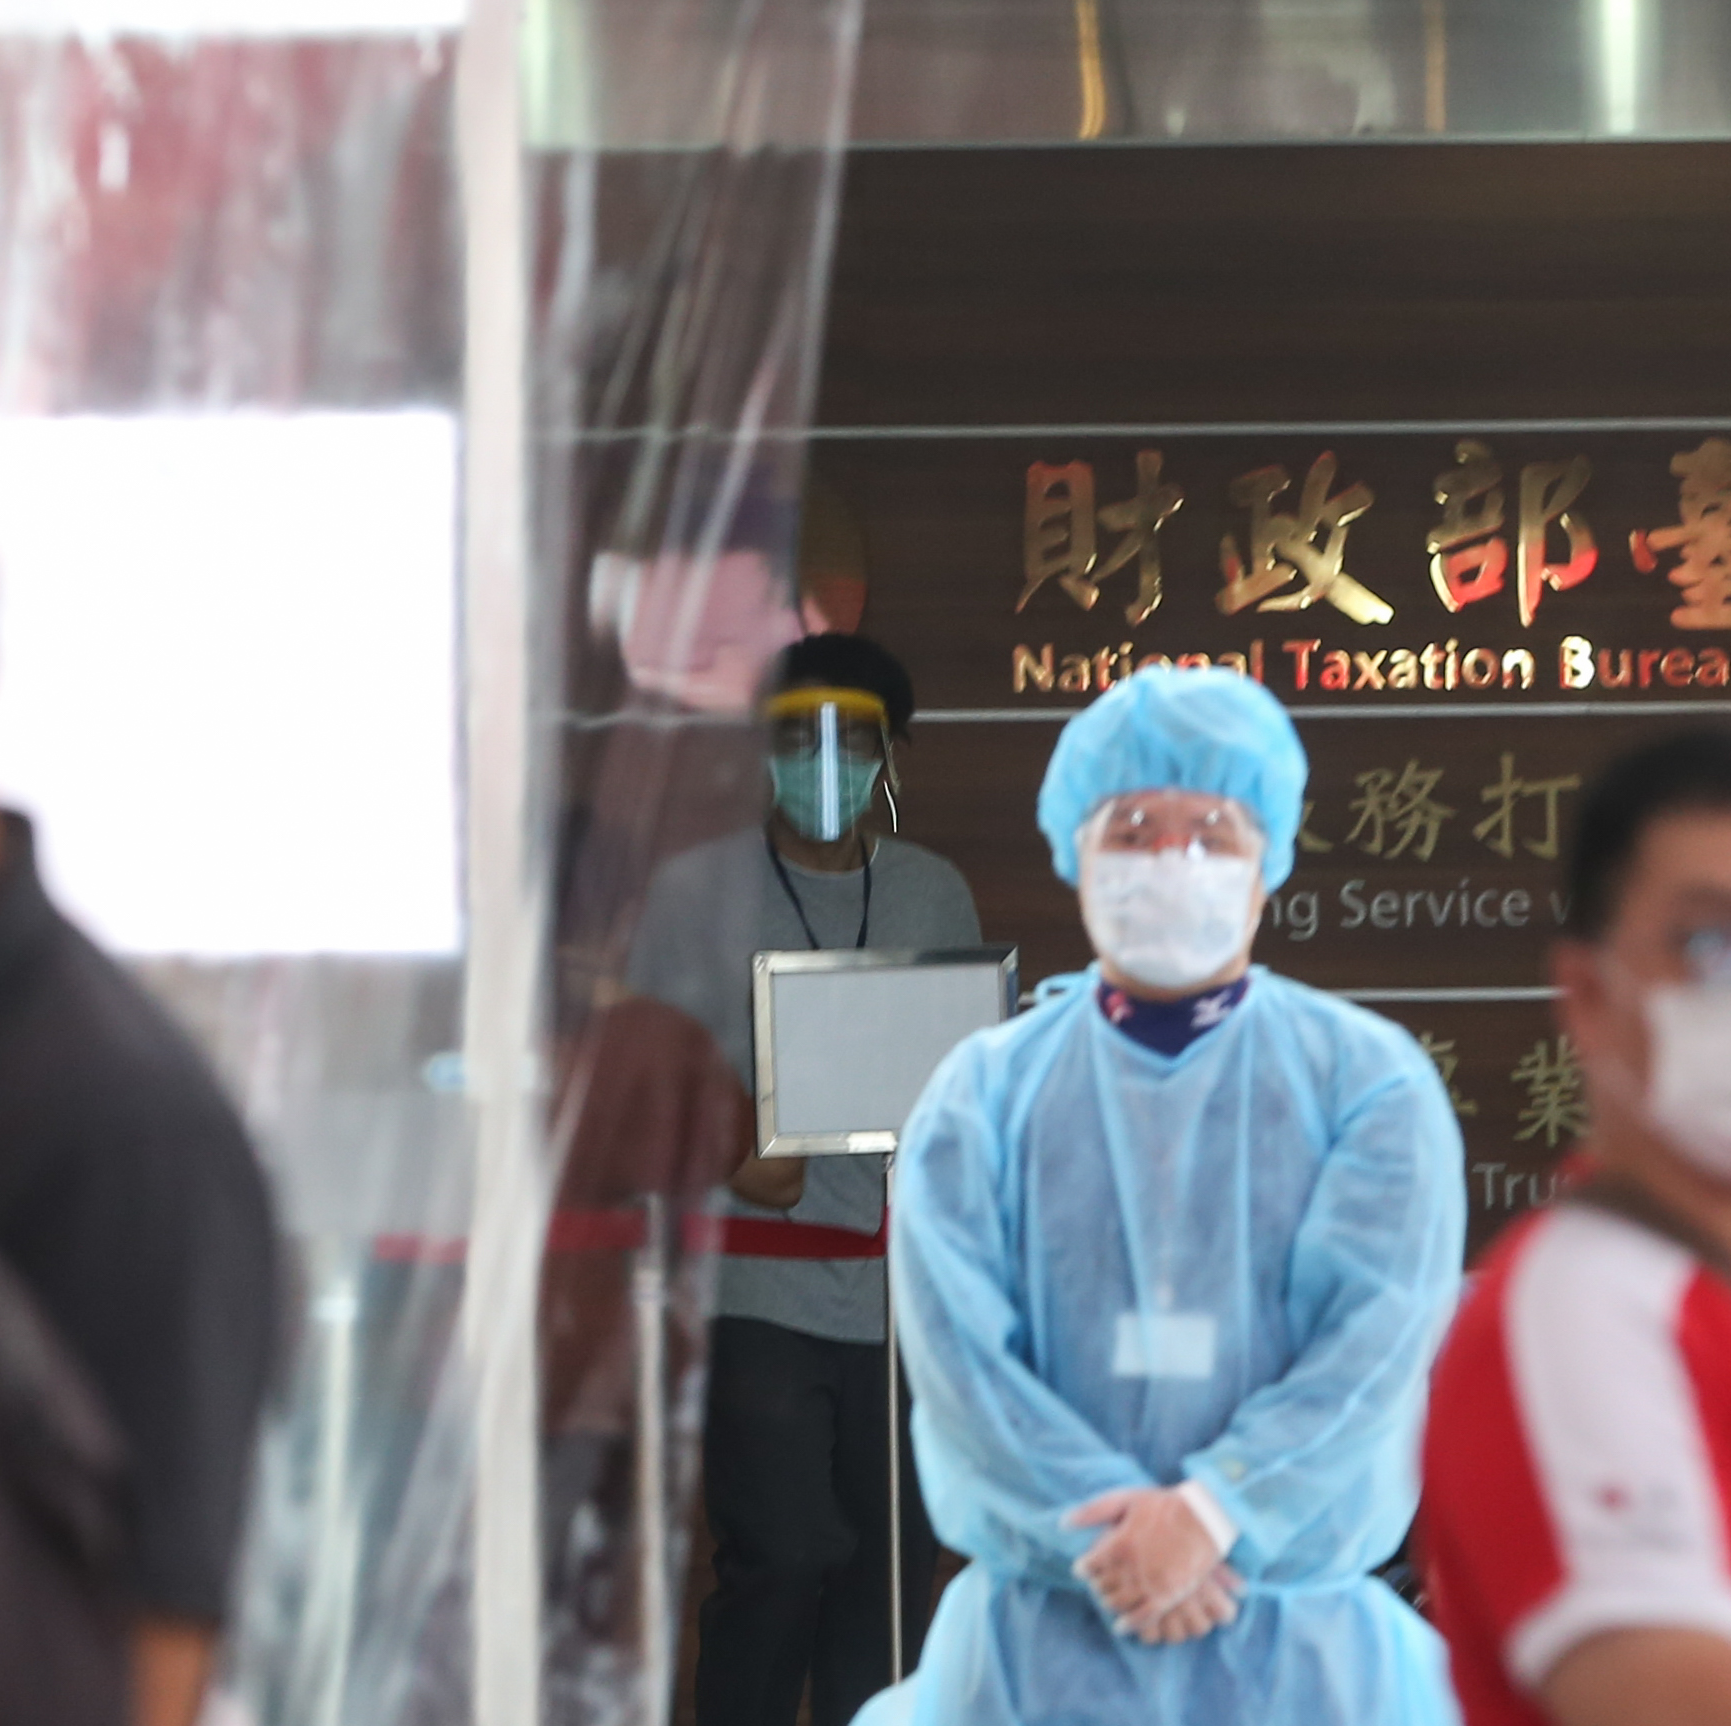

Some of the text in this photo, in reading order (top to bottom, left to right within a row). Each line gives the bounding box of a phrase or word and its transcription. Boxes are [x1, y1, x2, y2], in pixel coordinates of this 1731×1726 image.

[1281, 637, 1536, 690] Taxation
[1297, 751, 1582, 863] 務打
[1339, 876, 1532, 929] Service
